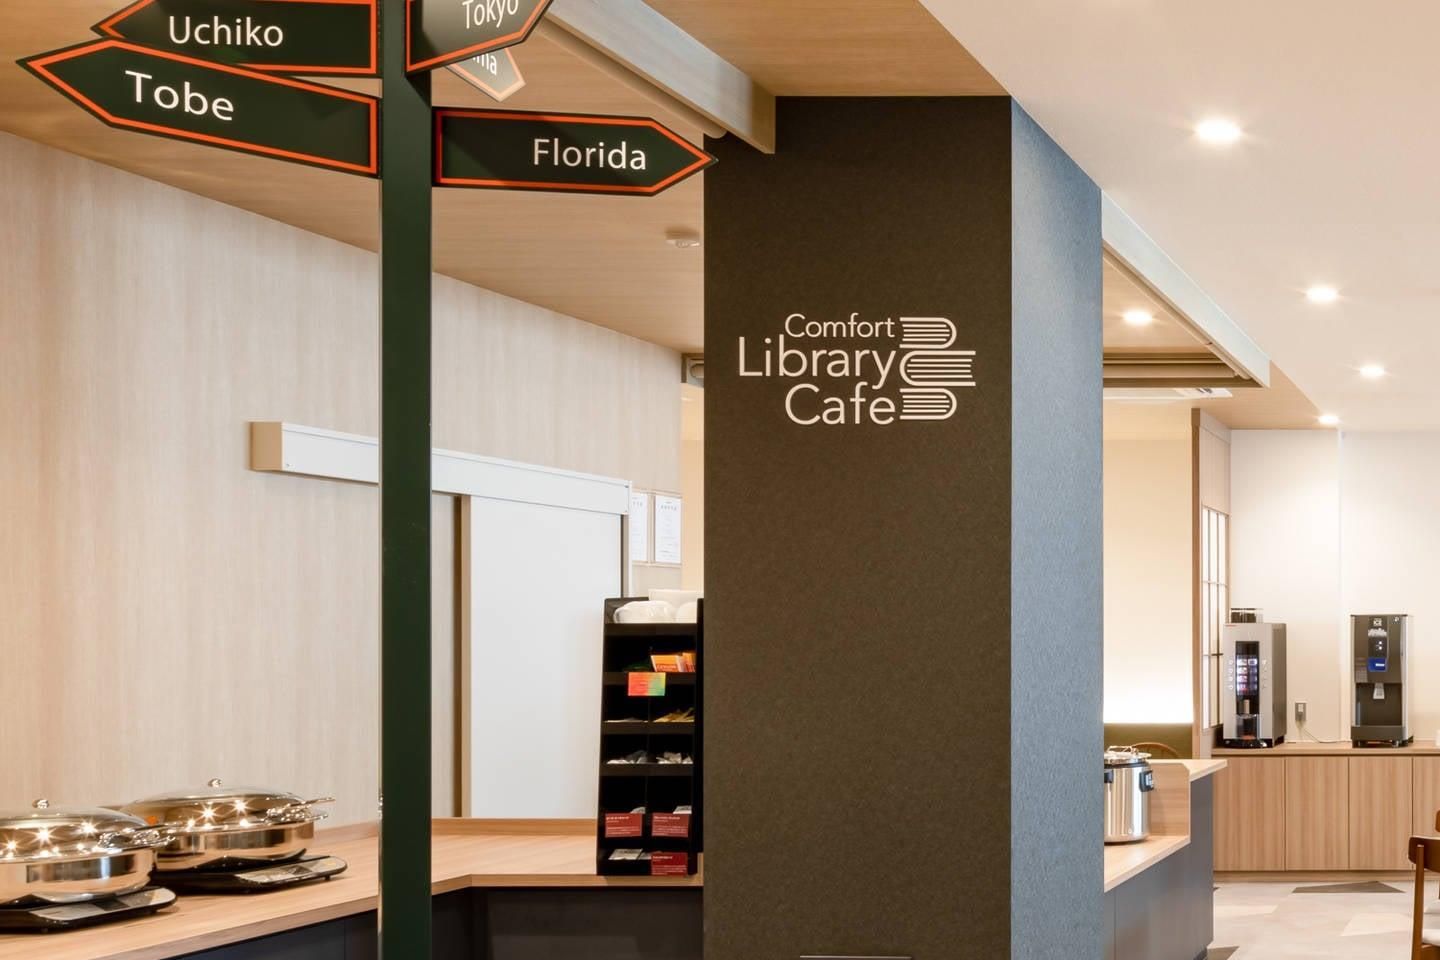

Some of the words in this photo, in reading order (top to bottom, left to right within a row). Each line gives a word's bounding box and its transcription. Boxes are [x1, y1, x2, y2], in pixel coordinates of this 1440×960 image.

[169, 15, 284, 47] Uchiko
[462, 0, 519, 29] Tokyo
[125, 70, 234, 121] Tobe
[534, 137, 646, 170] Florida
[785, 312, 895, 338] Comfort
[738, 334, 897, 390] Library
[785, 381, 896, 425] Cafe
